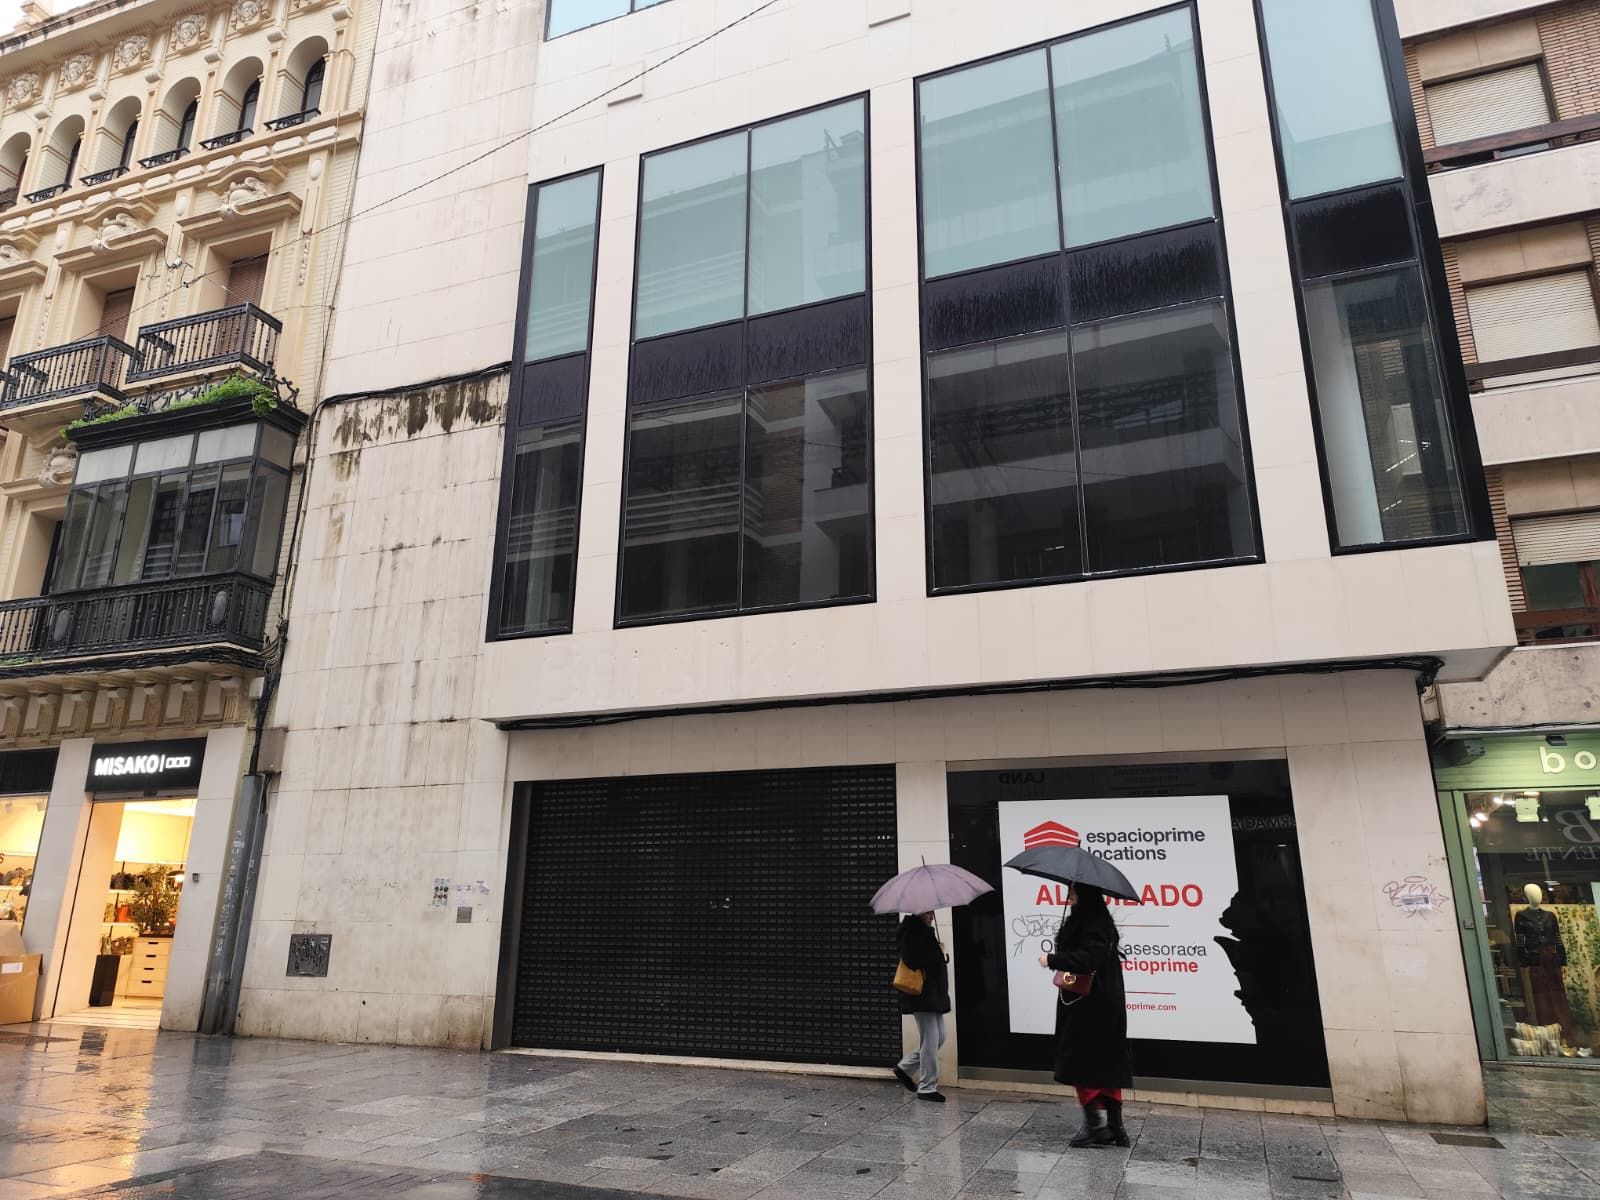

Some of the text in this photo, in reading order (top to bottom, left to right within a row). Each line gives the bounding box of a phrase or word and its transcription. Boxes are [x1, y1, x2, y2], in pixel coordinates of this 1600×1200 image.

[94, 754, 159, 776] MISAKO
[1086, 828, 1206, 845] espacioprime
[1036, 884, 1203, 907] ALADO
[1120, 957, 1199, 975] cioprime
[1125, 1002, 1177, 1011] oprime.com
